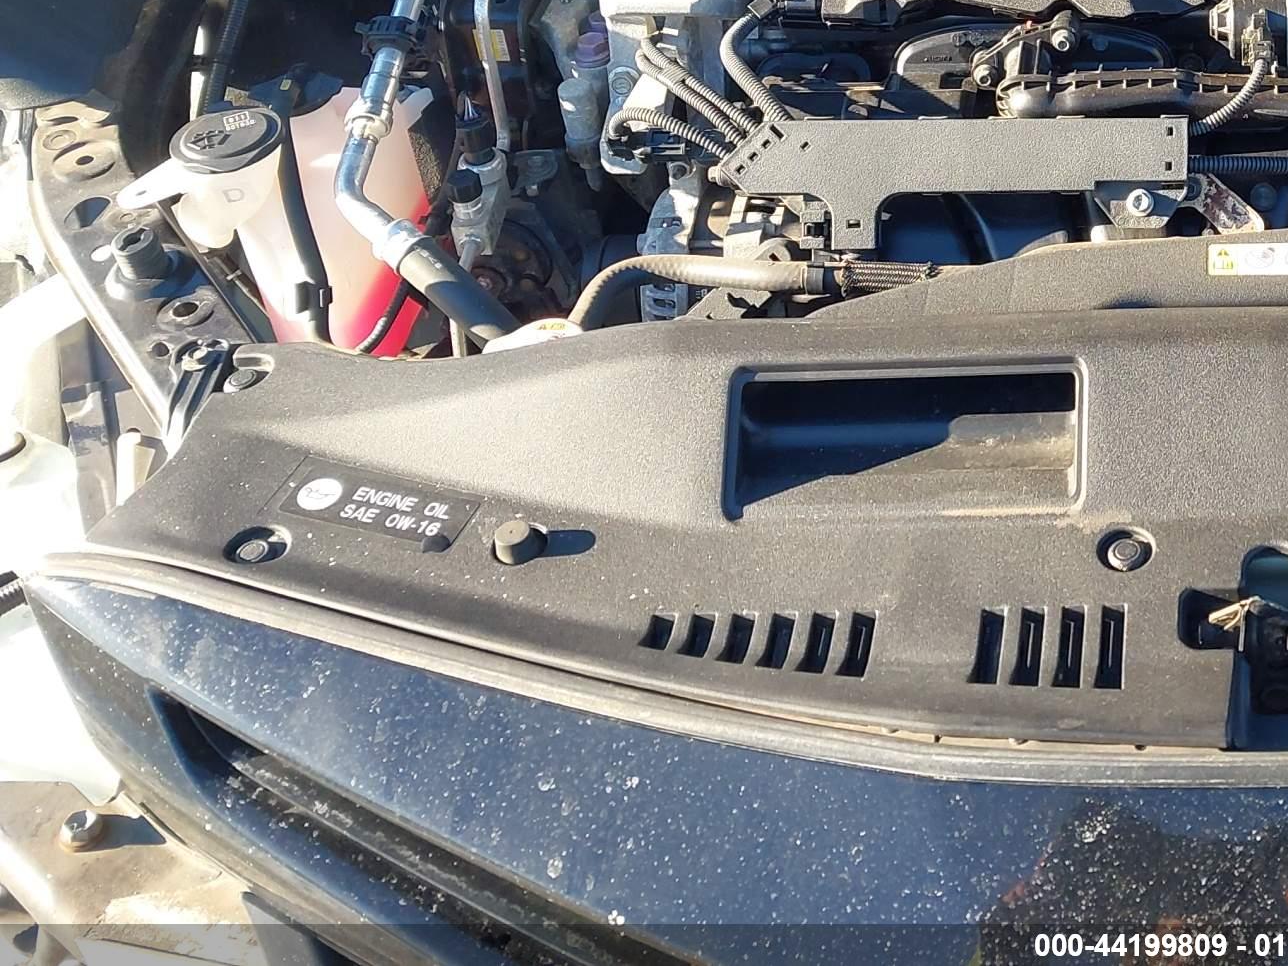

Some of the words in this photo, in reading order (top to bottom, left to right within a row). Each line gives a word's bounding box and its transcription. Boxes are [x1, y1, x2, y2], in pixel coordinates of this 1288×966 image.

[352, 486, 418, 512] ENGINE
[424, 502, 450, 519] OIL
[340, 504, 380, 523] SAE
[385, 513, 441, 536] 0W-16
